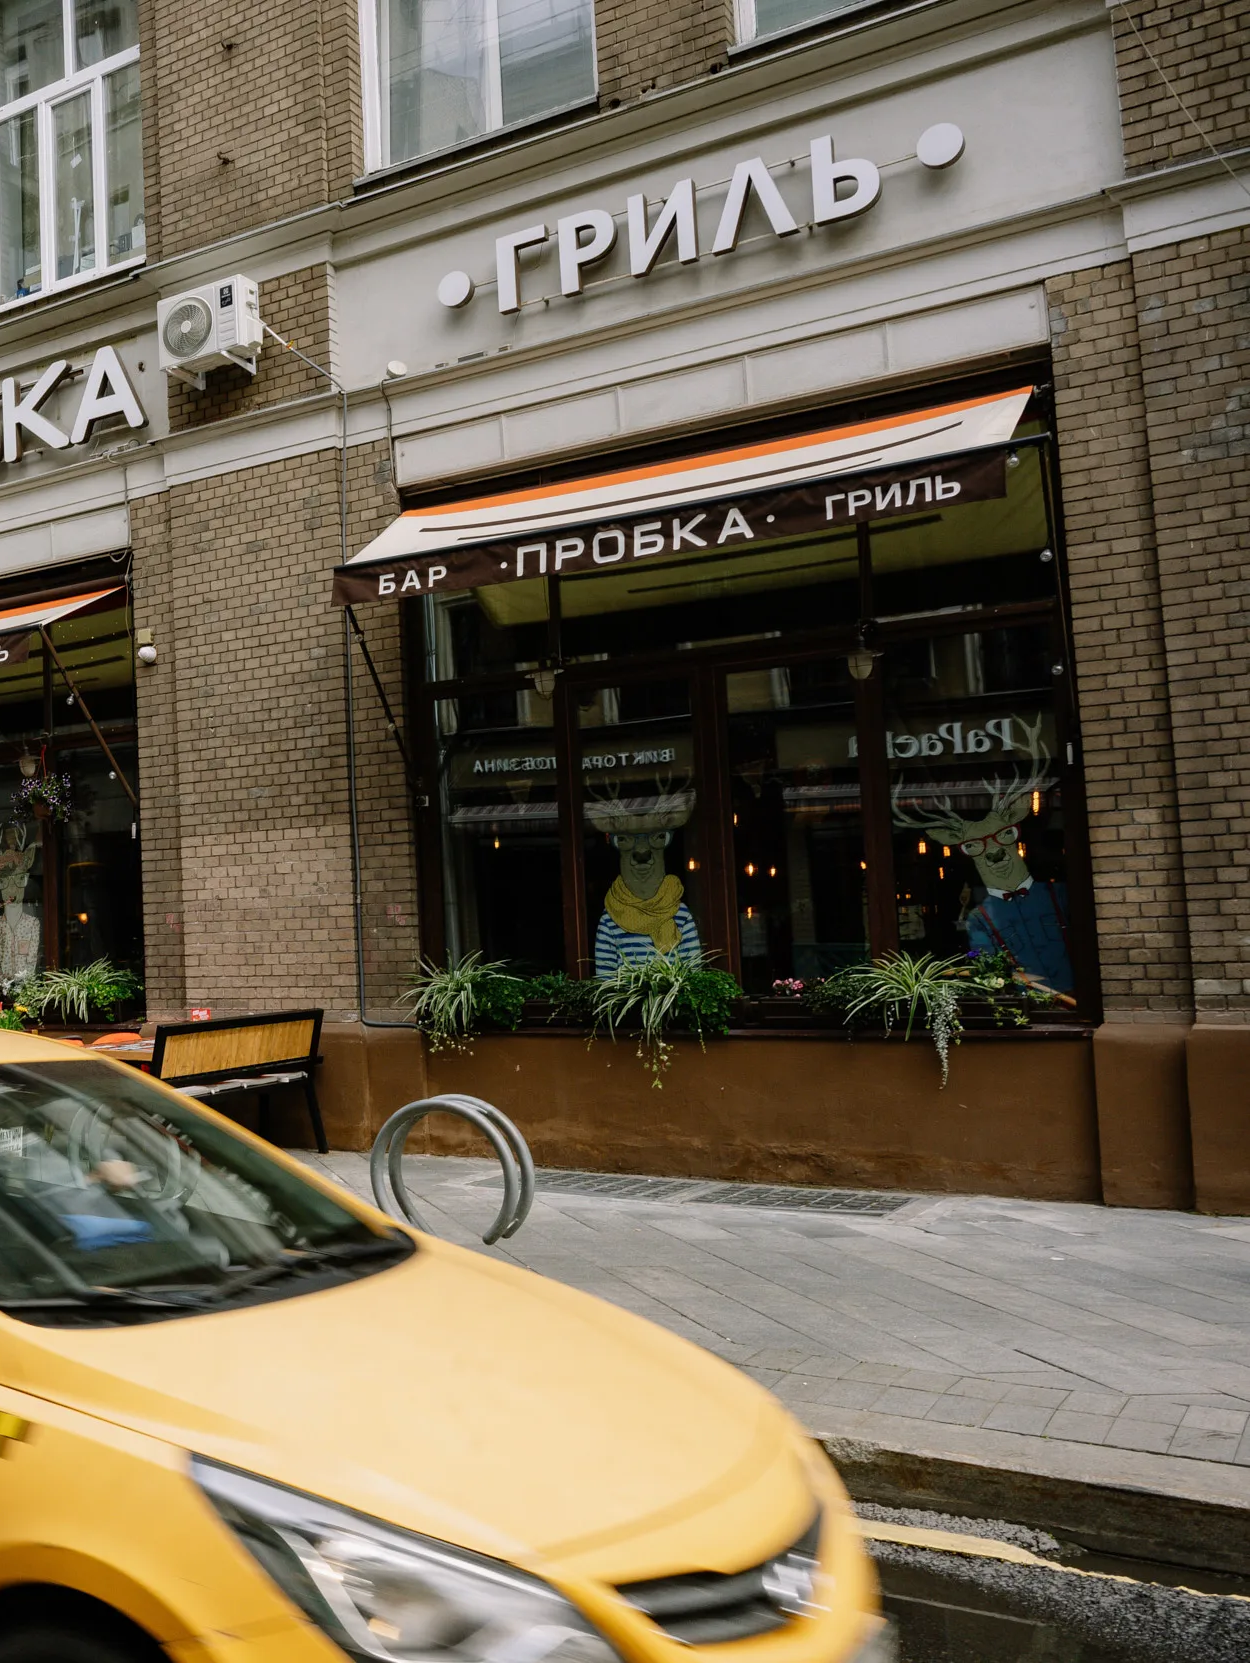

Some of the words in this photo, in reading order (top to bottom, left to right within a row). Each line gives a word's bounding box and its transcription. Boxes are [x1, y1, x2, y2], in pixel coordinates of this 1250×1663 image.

[496, 135, 883, 315] ГРИЛЬ
[378, 565, 447, 595] БАР
[515, 507, 754, 577] ПРОБКА
[824, 475, 961, 520] ГРИЛЬ
